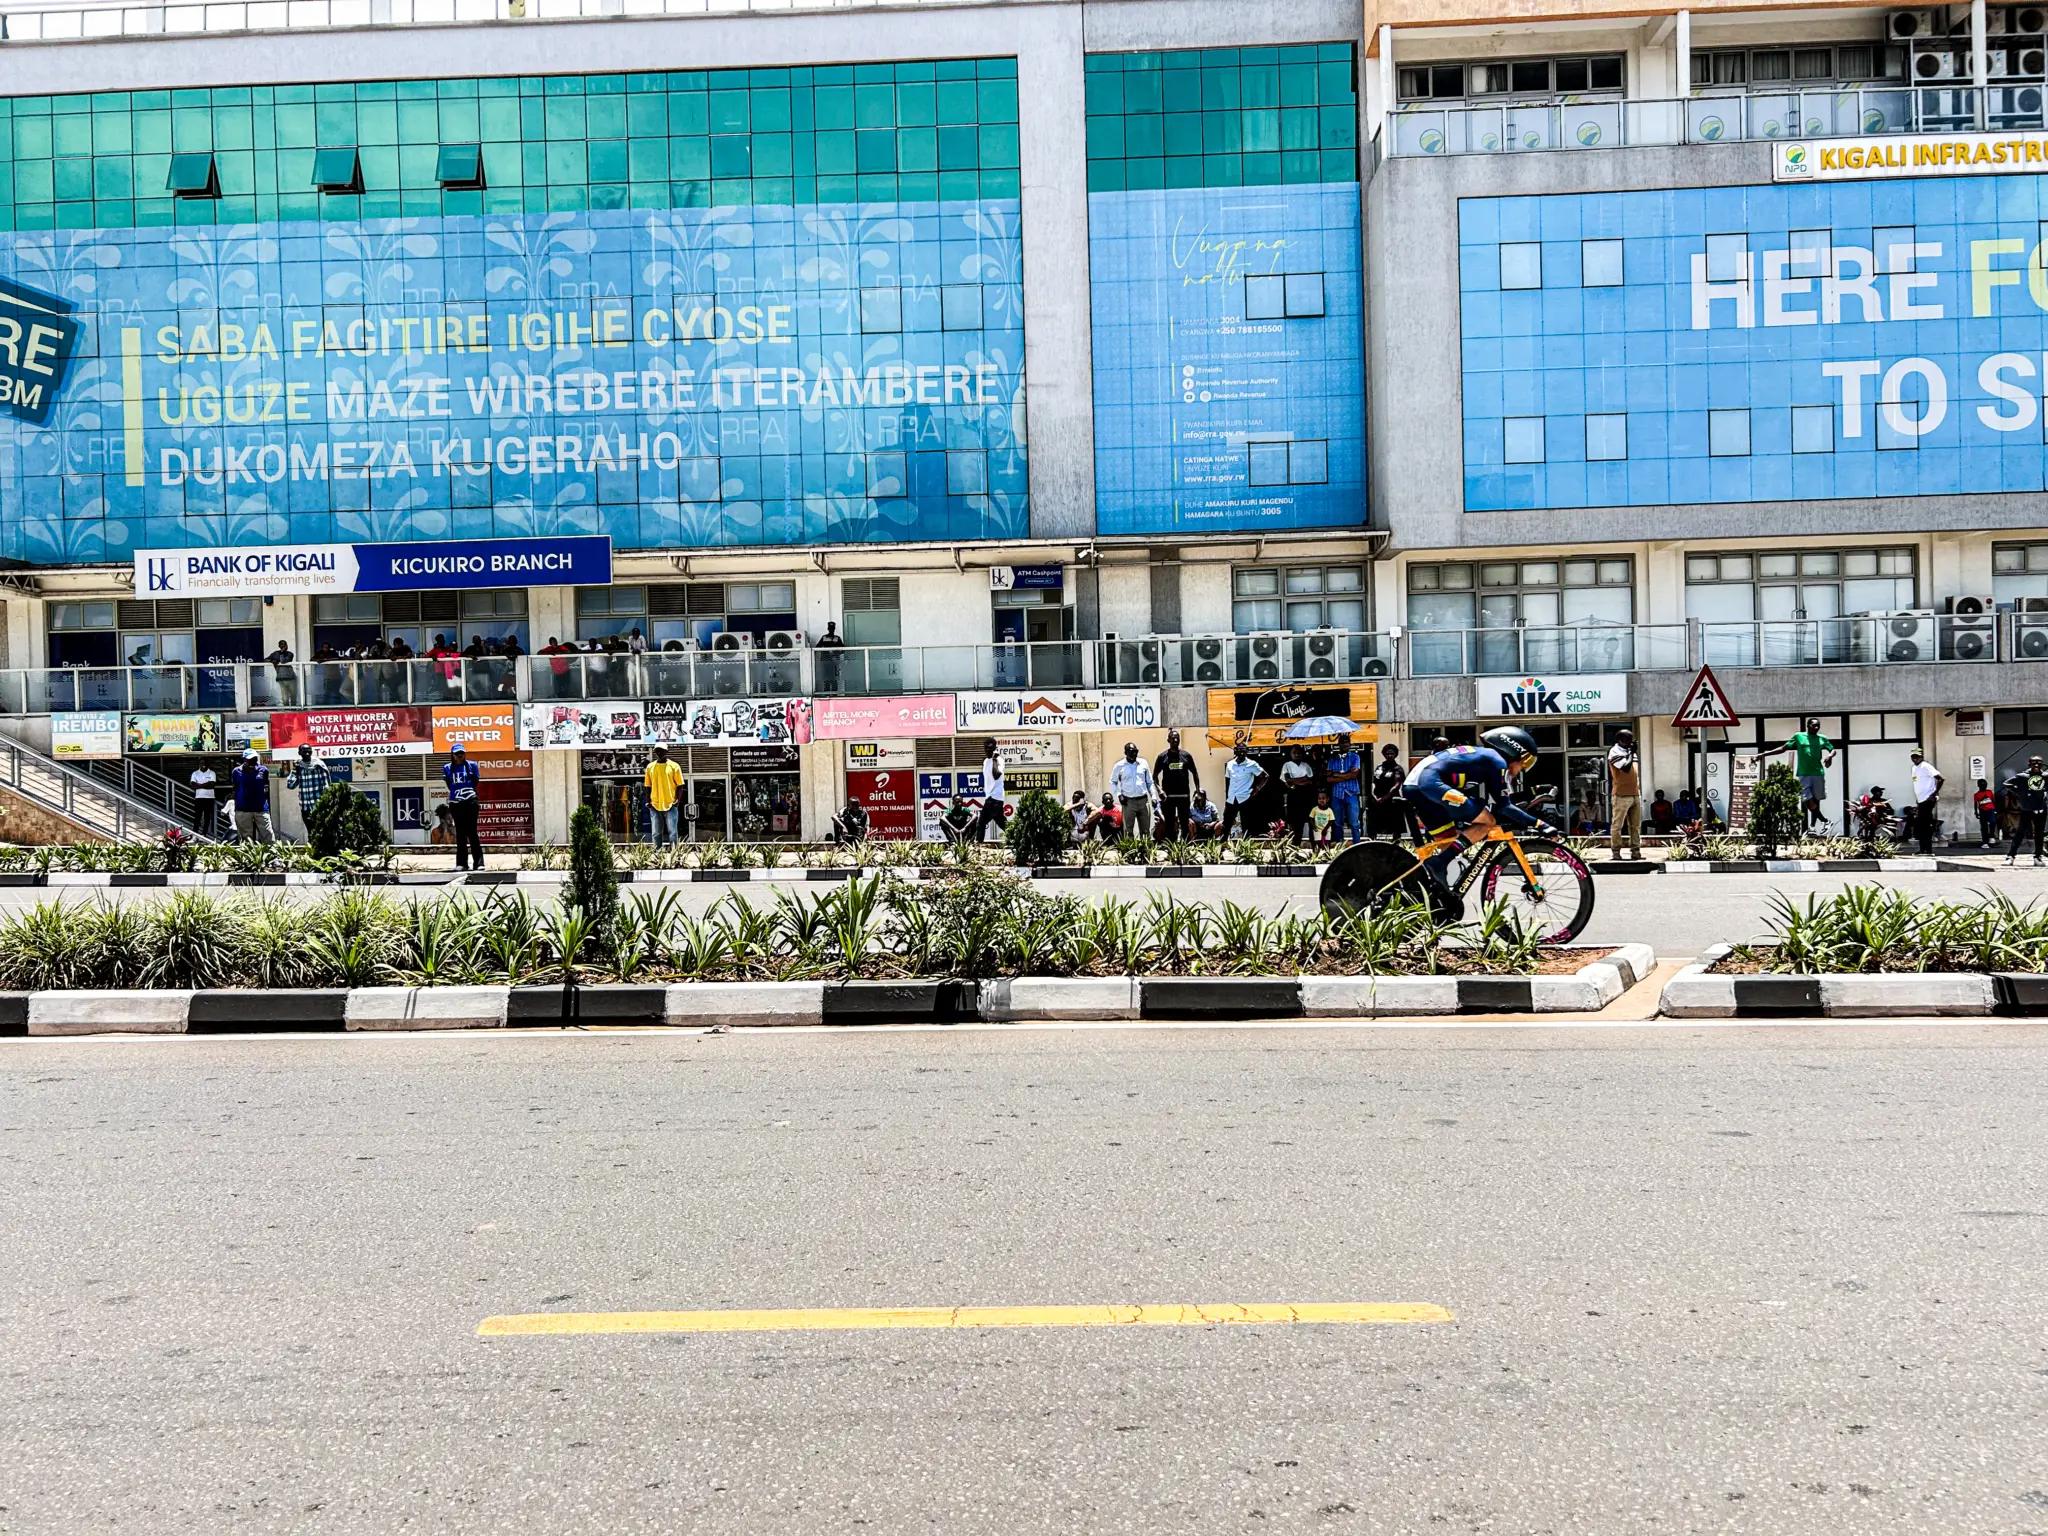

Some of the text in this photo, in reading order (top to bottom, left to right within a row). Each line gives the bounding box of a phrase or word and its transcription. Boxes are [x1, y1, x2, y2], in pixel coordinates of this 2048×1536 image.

[1820, 145, 1907, 170] KIGALI
[1785, 165, 1808, 173] NPD
[1690, 238, 2048, 330] HERE F
[156, 305, 792, 364] SABA FAGITIRE IGIHE CYOSE
[158, 364, 999, 427] UGUZE MAZE WIREBERE ITERAMBERE
[1823, 353, 2048, 439] TO S
[1183, 430, 1246, 440] info@rra.gov.rw
[160, 431, 682, 487] DUKOMEZA KUGERAHO
[1215, 455, 1238, 463] NATWE
[1184, 474, 1245, 483] www.rra.gov.rw
[1205, 499, 1240, 507] AMAKURU
[1259, 496, 1293, 505] MAGENDU
[1261, 507, 1281, 516] 3005
[188, 552, 336, 574] BANK OF KIGALI
[391, 553, 573, 575] KICUKIRO BRANCH
[188, 573, 336, 588] Financially transforming lives
[208, 655, 233, 667] Skip
[208, 669, 236, 679] queu
[1566, 690, 1601, 700] SALON
[972, 701, 1015, 714] BANK OF KIGALI
[1501, 691, 1562, 714] NIK
[1566, 704, 1591, 713] KIDS
[307, 712, 395, 724] NOTERI WIKORERA
[823, 710, 880, 719] AIRTEL MONEY
[912, 706, 947, 720] airtel
[53, 719, 119, 732] IREMBO
[151, 719, 196, 731] MOANA
[432, 715, 514, 728] MANGO 4G
[823, 718, 855, 727] BRANCH
[1024, 715, 1066, 725] EQUITY
[310, 722, 393, 734] PRIVATE NOTARY
[316, 732, 388, 743] NOTAIRE PRIVE
[445, 731, 501, 742] CENTER
[315, 744, 406, 757] Tel: 0795926206
[478, 759, 530, 769] ANGO 4G
[869, 790, 897, 801] airtel
[477, 816, 499, 824] IVATE
[1459, 847, 1492, 893] cannondale
